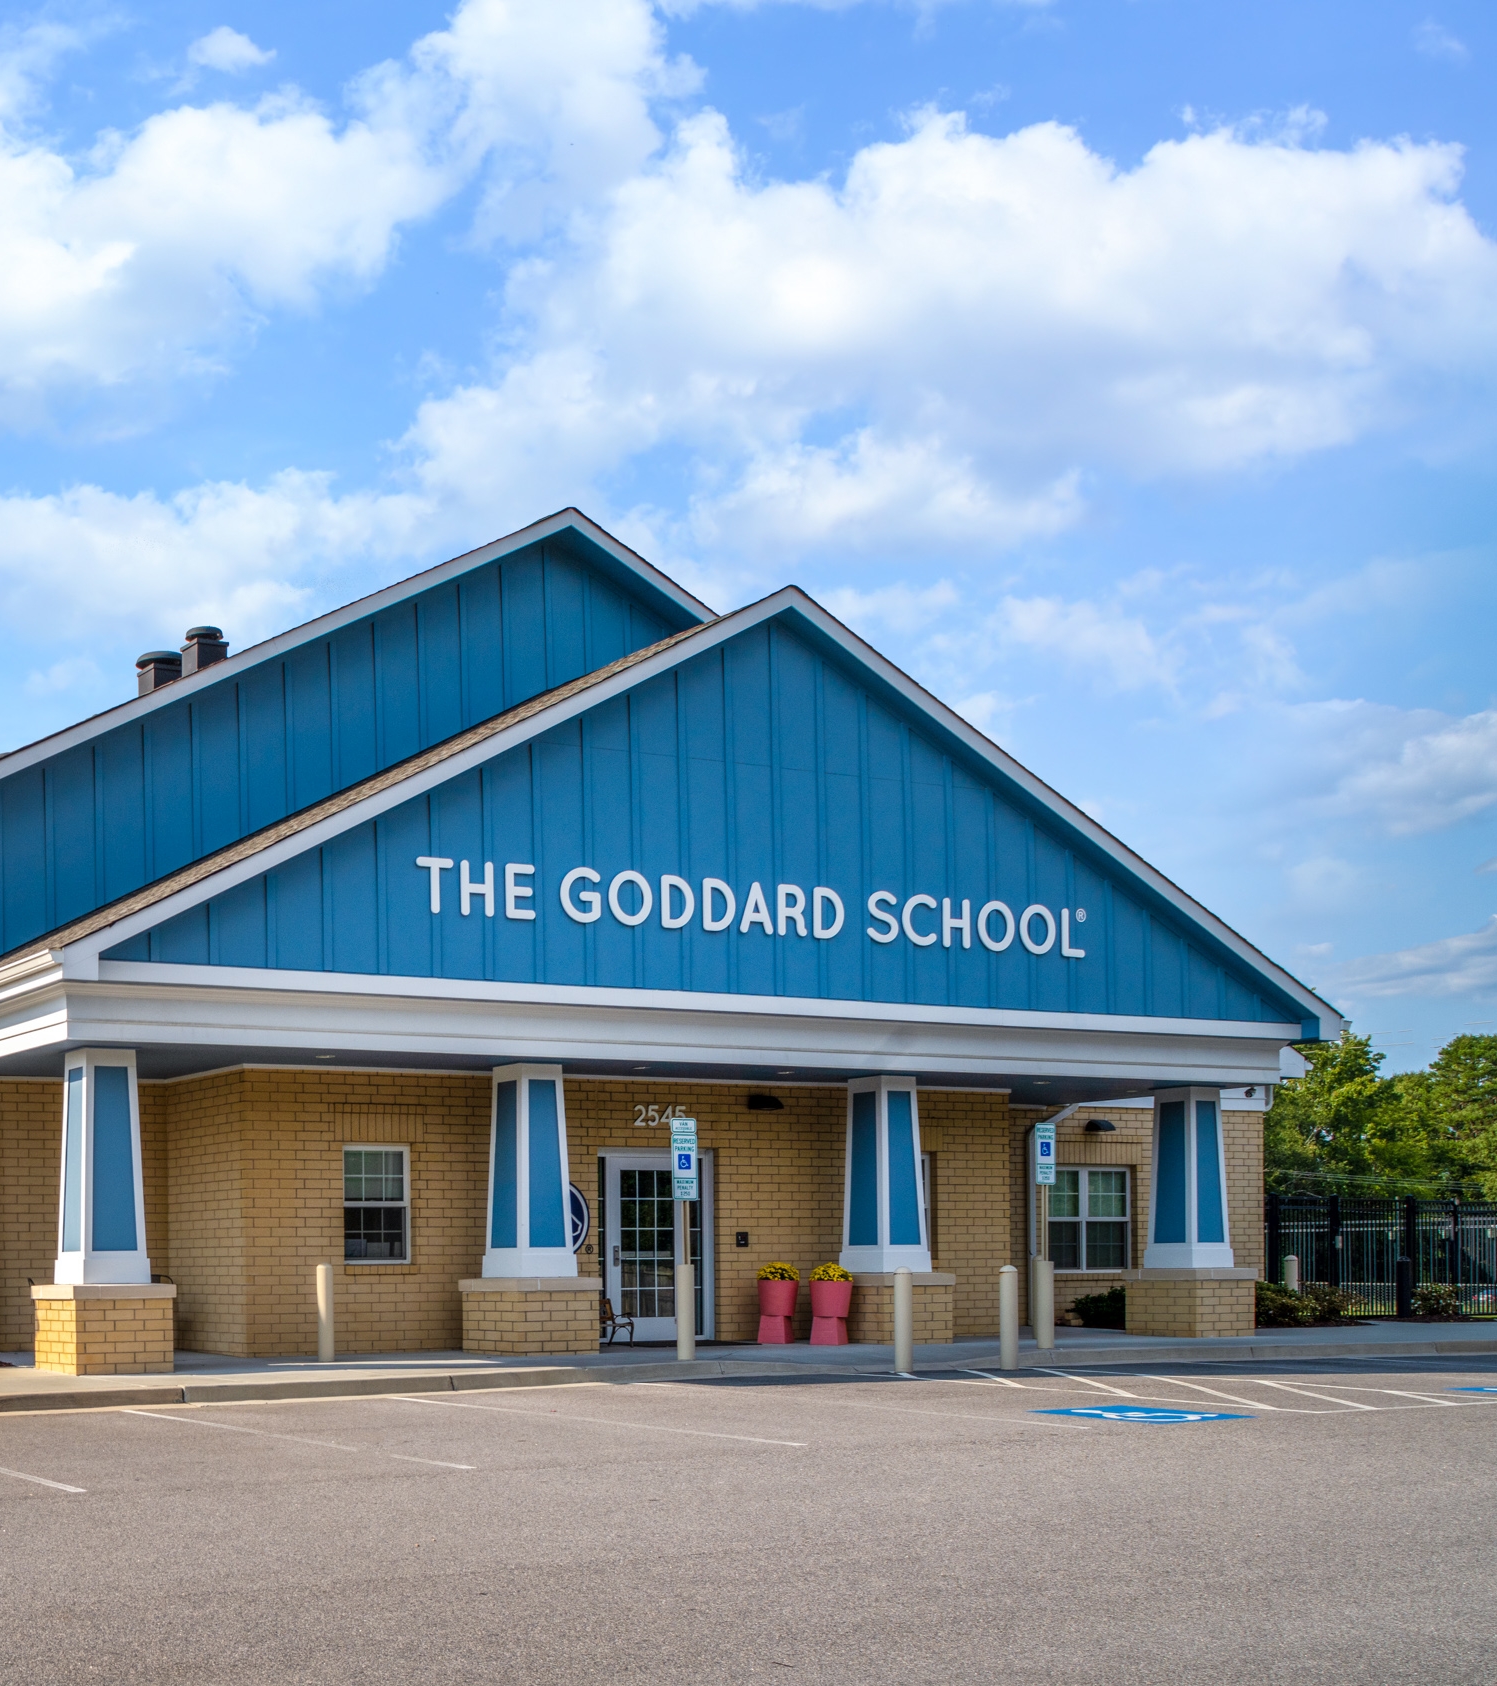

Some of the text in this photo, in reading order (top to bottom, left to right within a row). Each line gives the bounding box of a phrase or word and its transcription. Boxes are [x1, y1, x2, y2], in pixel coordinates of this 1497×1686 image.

[416, 856, 536, 920] THE
[560, 866, 845, 940] GODDARD
[634, 1104, 686, 1126] 2545
